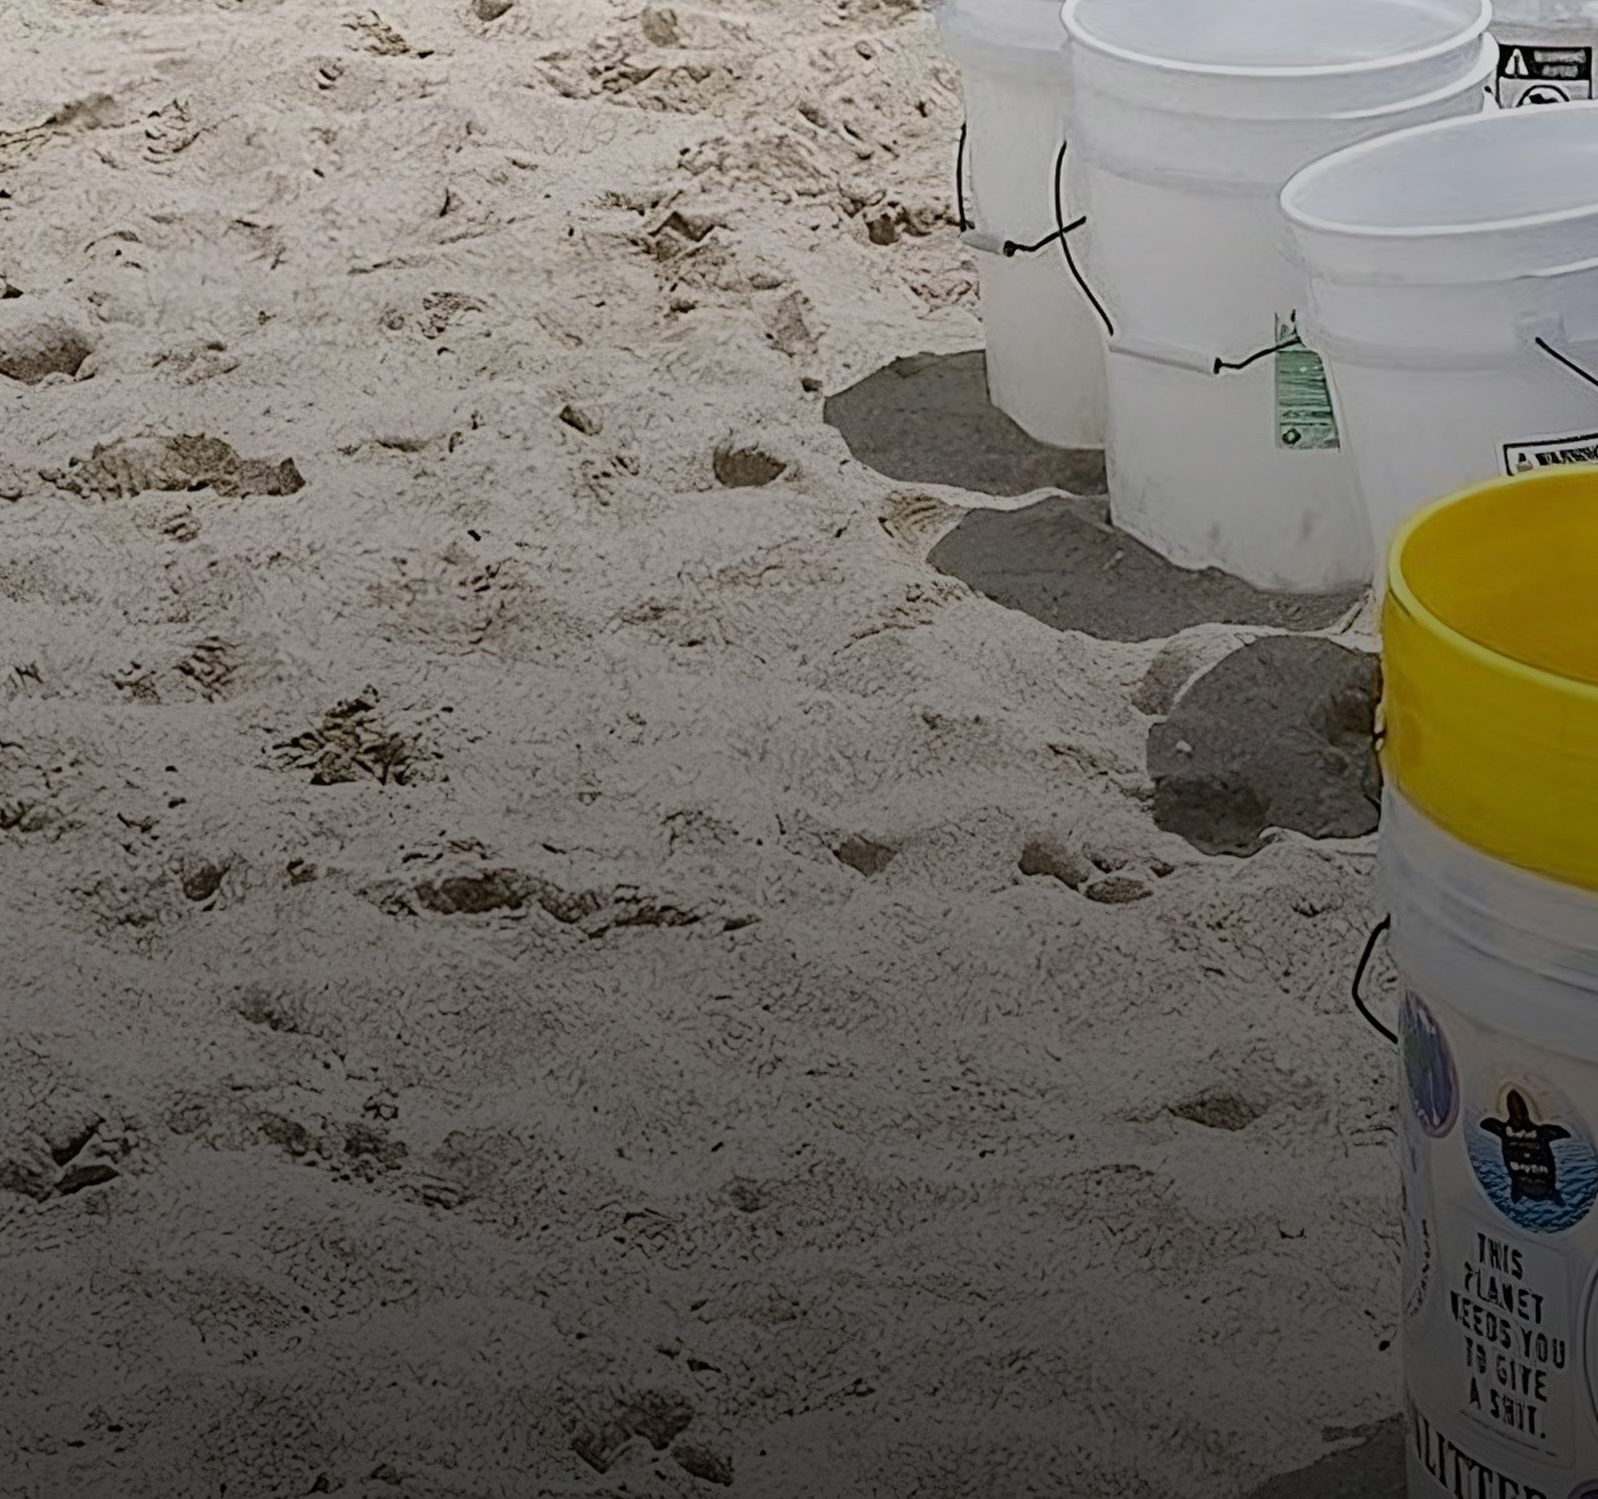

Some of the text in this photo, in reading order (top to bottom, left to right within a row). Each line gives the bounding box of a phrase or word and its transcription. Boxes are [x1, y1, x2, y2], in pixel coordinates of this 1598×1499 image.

[1476, 1232, 1523, 1281] THIS
[1463, 1262, 1543, 1325] PLANET
[1522, 1316, 1566, 1370] YOU
[1468, 1376, 1481, 1411] A
[1496, 1347, 1547, 1402] GIVE
